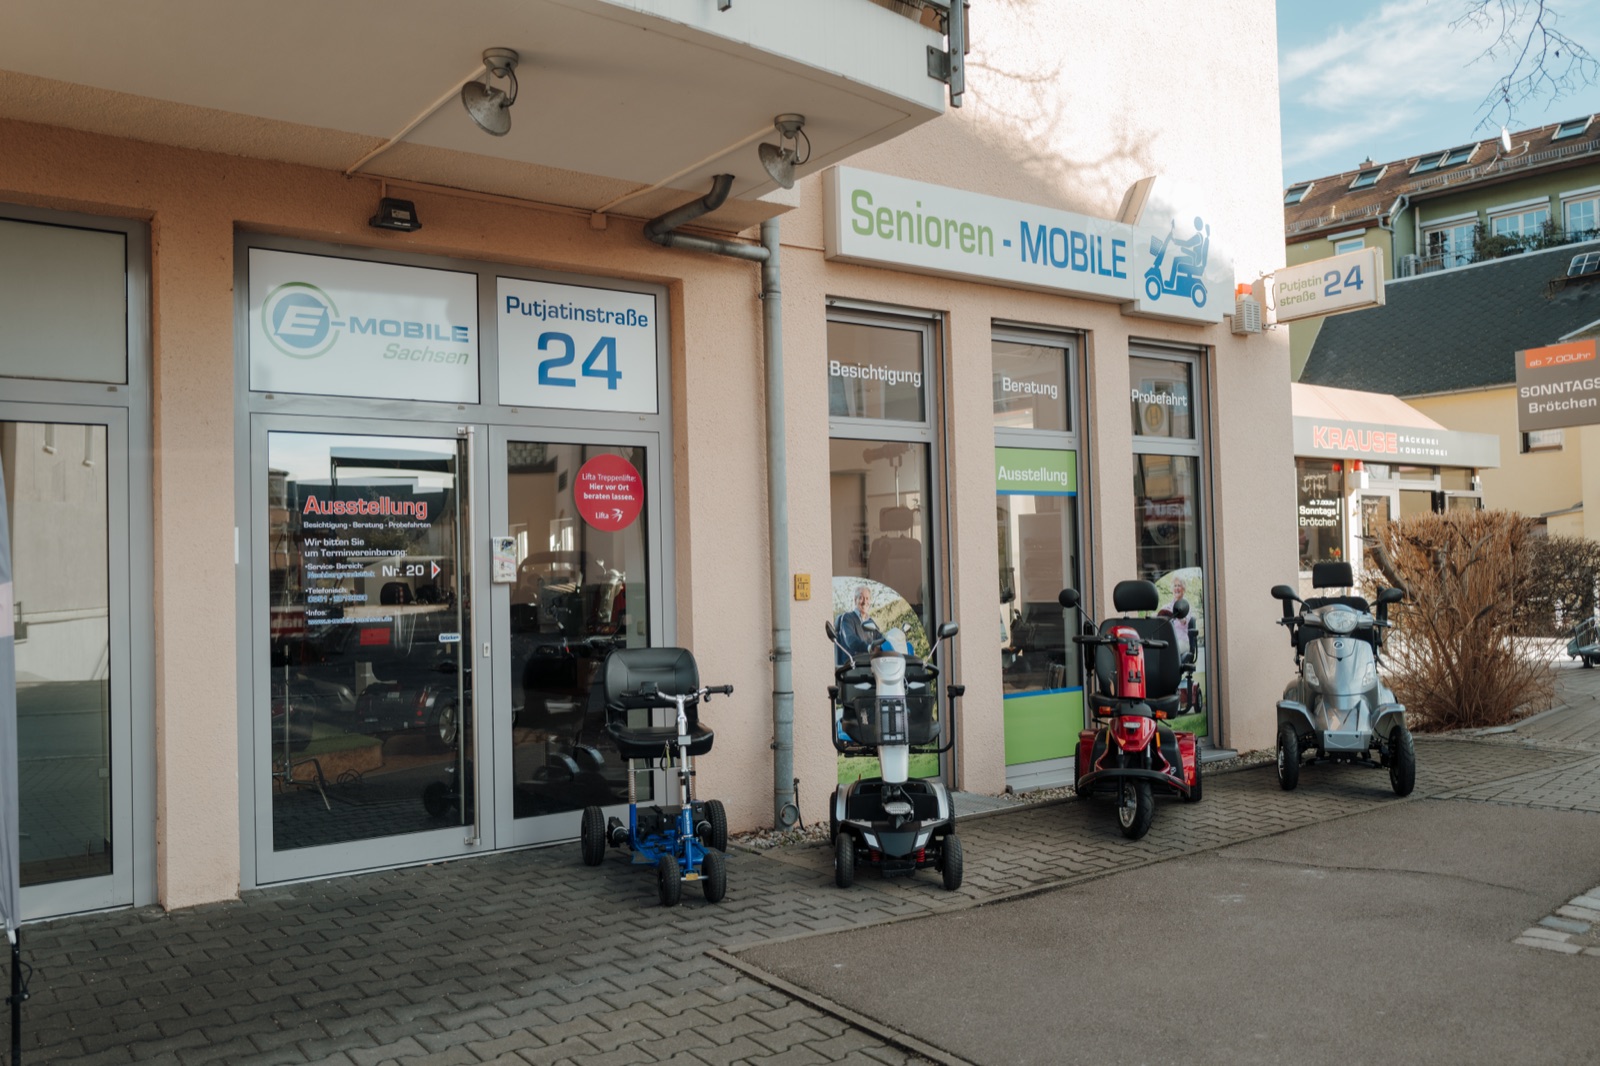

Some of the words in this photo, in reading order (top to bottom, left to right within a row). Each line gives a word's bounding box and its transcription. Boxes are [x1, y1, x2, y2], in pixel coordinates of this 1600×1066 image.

[851, 189, 994, 257] Senioren
[1020, 220, 1127, 280] MOBILE
[1279, 275, 1322, 294] Putjatin
[1323, 265, 1364, 297] 24
[1280, 291, 1316, 307] straße
[505, 295, 649, 328] Putjatinstraße
[382, 342, 470, 365] Sachsen
[537, 331, 623, 391] 24
[1529, 359, 1542, 367] ab
[829, 360, 922, 388] Besichtigung
[1002, 376, 1058, 399] Beratung
[1131, 388, 1187, 407] Probefahrt
[1528, 397, 1597, 414] Brötchen
[1313, 425, 1398, 454] KRAUSE
[1399, 446, 1449, 456] KONDITOREI
[582, 472, 596, 480] Lifta
[997, 465, 1068, 486] Ausstellung
[611, 493, 635, 501] lassen.
[303, 495, 428, 520] Ausstellung
[595, 511, 609, 519] Lifta
[1299, 505, 1336, 517] Sonntags
[303, 521, 348, 530] Besichtigung
[352, 521, 384, 530] Beratung
[388, 521, 432, 529] Probefahrten
[1299, 516, 1337, 527] Brötchen
[304, 538, 321, 546] Wir
[323, 537, 349, 546] bitten
[351, 537, 365, 546] Sie
[320, 548, 408, 558] Terminvereinbarung:
[382, 565, 403, 577] Nr.
[406, 564, 424, 577] 20
